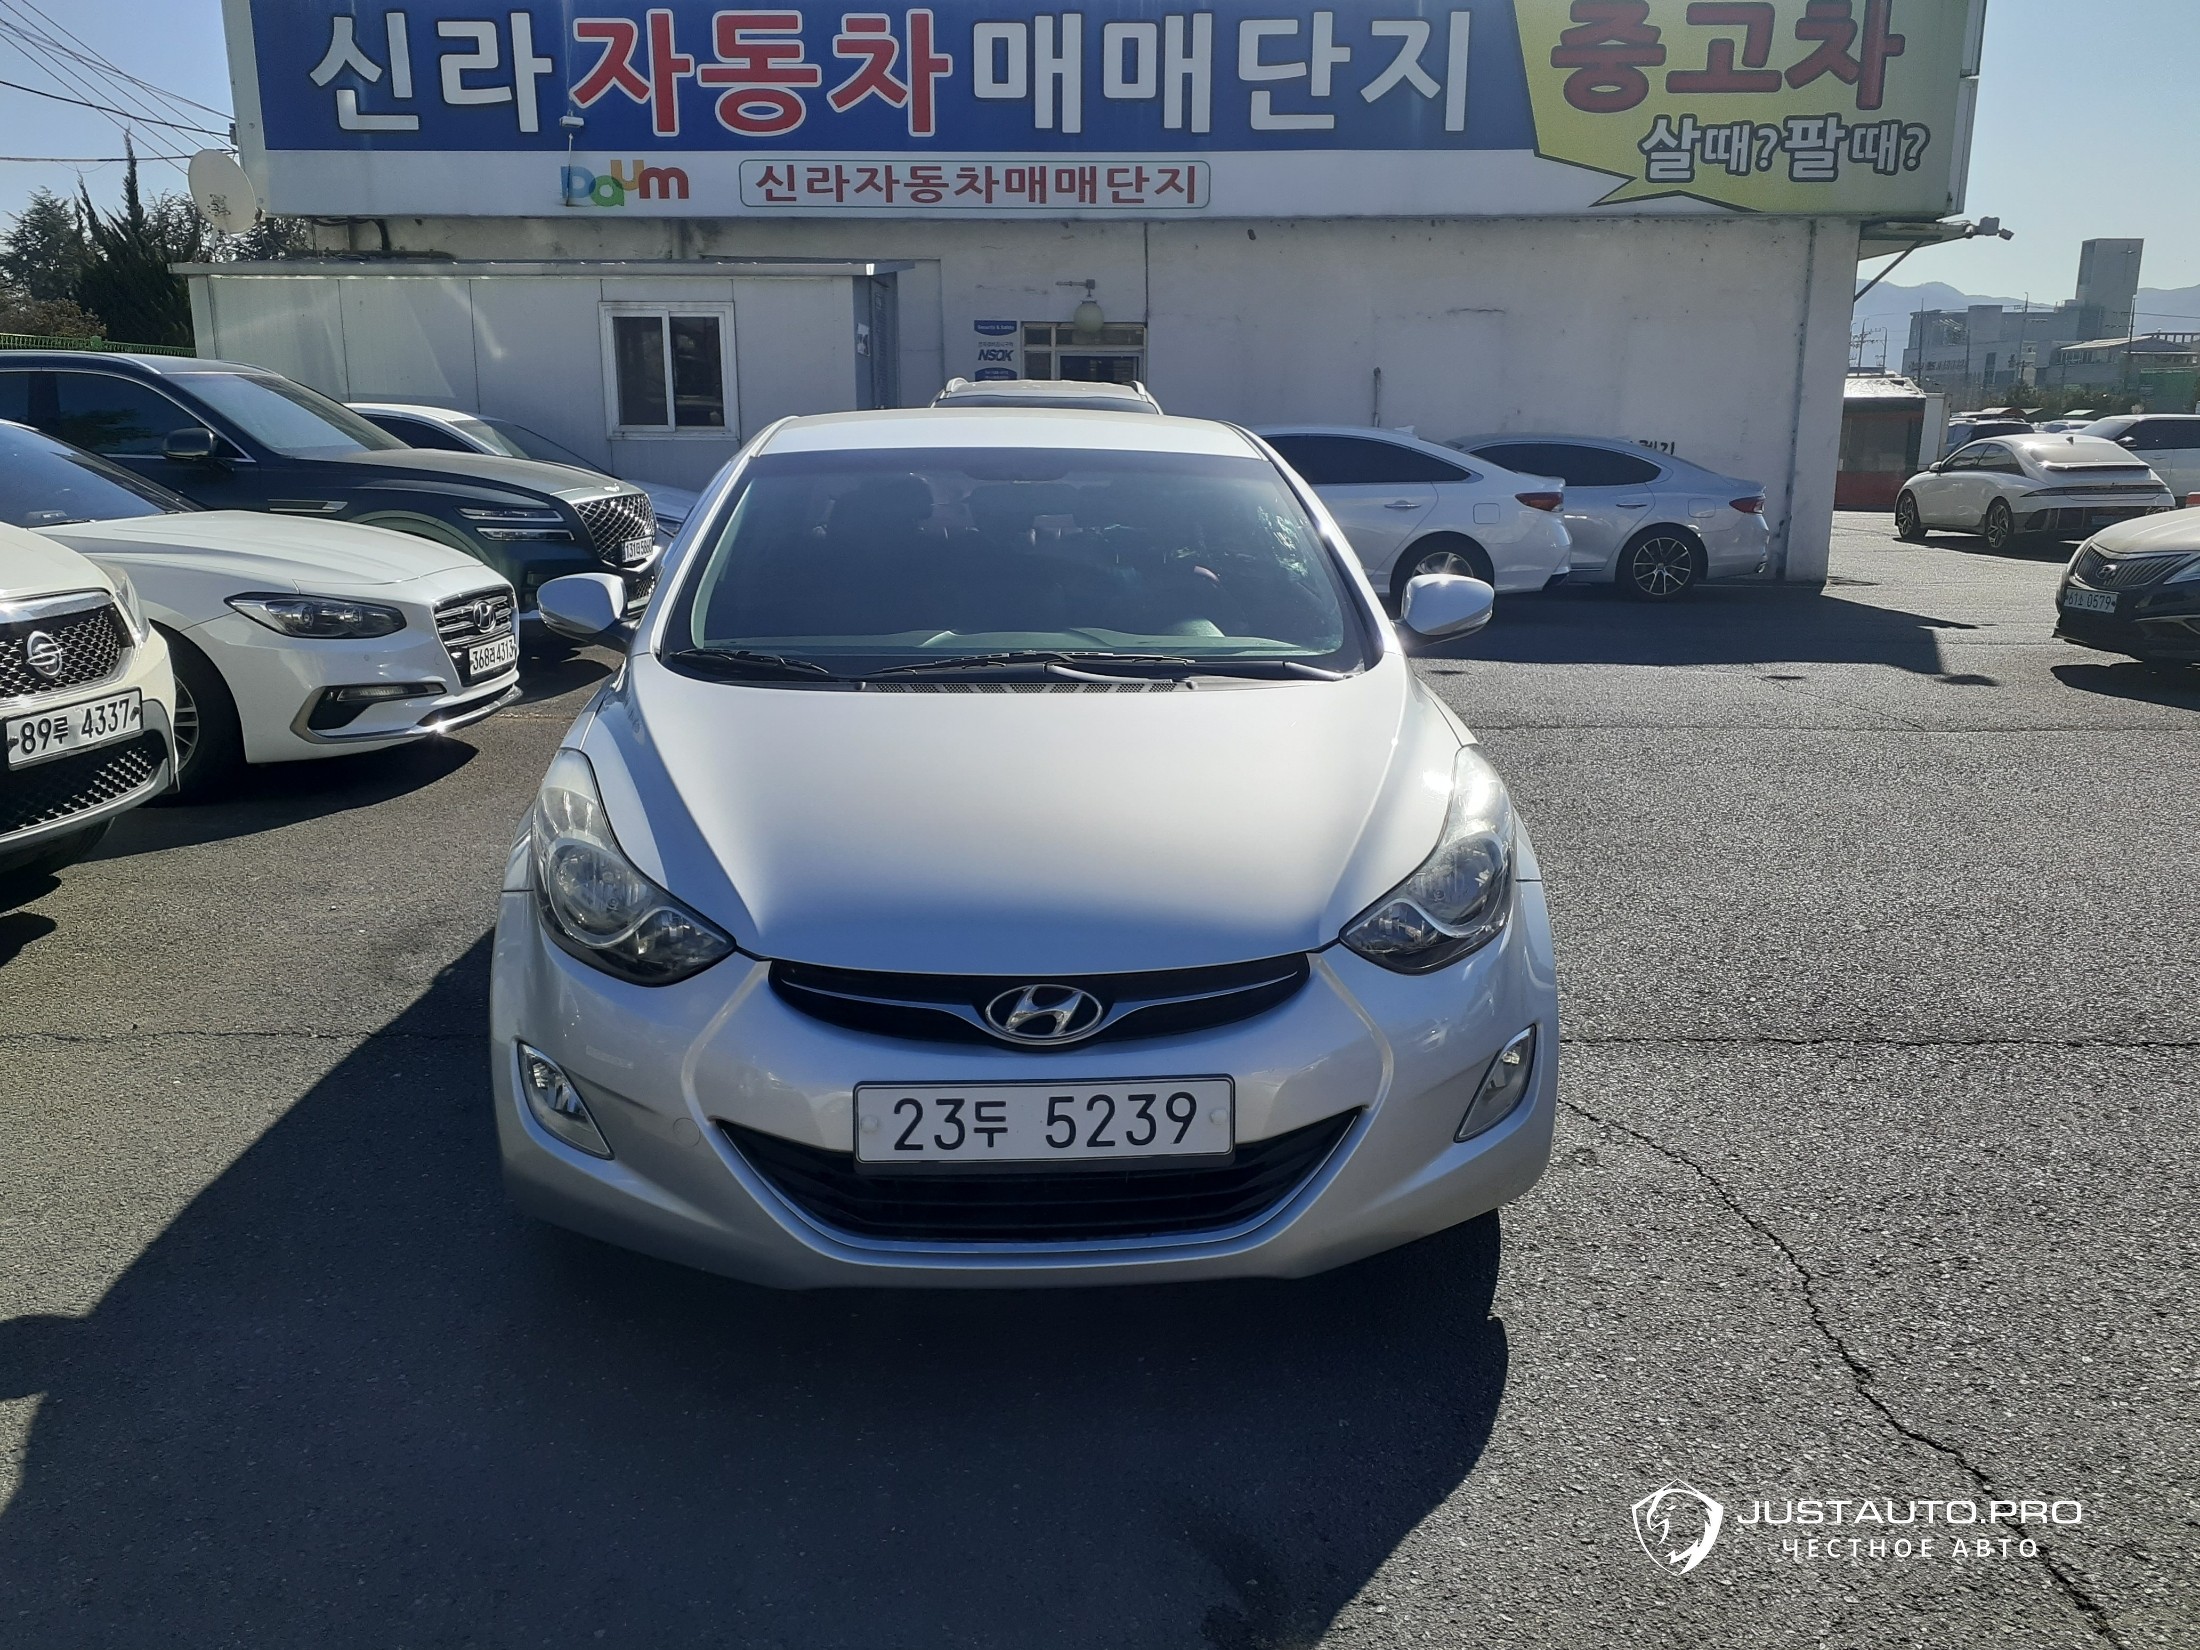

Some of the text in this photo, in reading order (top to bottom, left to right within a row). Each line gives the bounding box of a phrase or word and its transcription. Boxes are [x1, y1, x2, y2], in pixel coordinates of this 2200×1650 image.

[1550, 0, 1906, 113] 중고차
[978, 349, 1014, 361] NSOK
[81, 698, 130, 738] 4337
[893, 1091, 1197, 1150] 23두 5239
